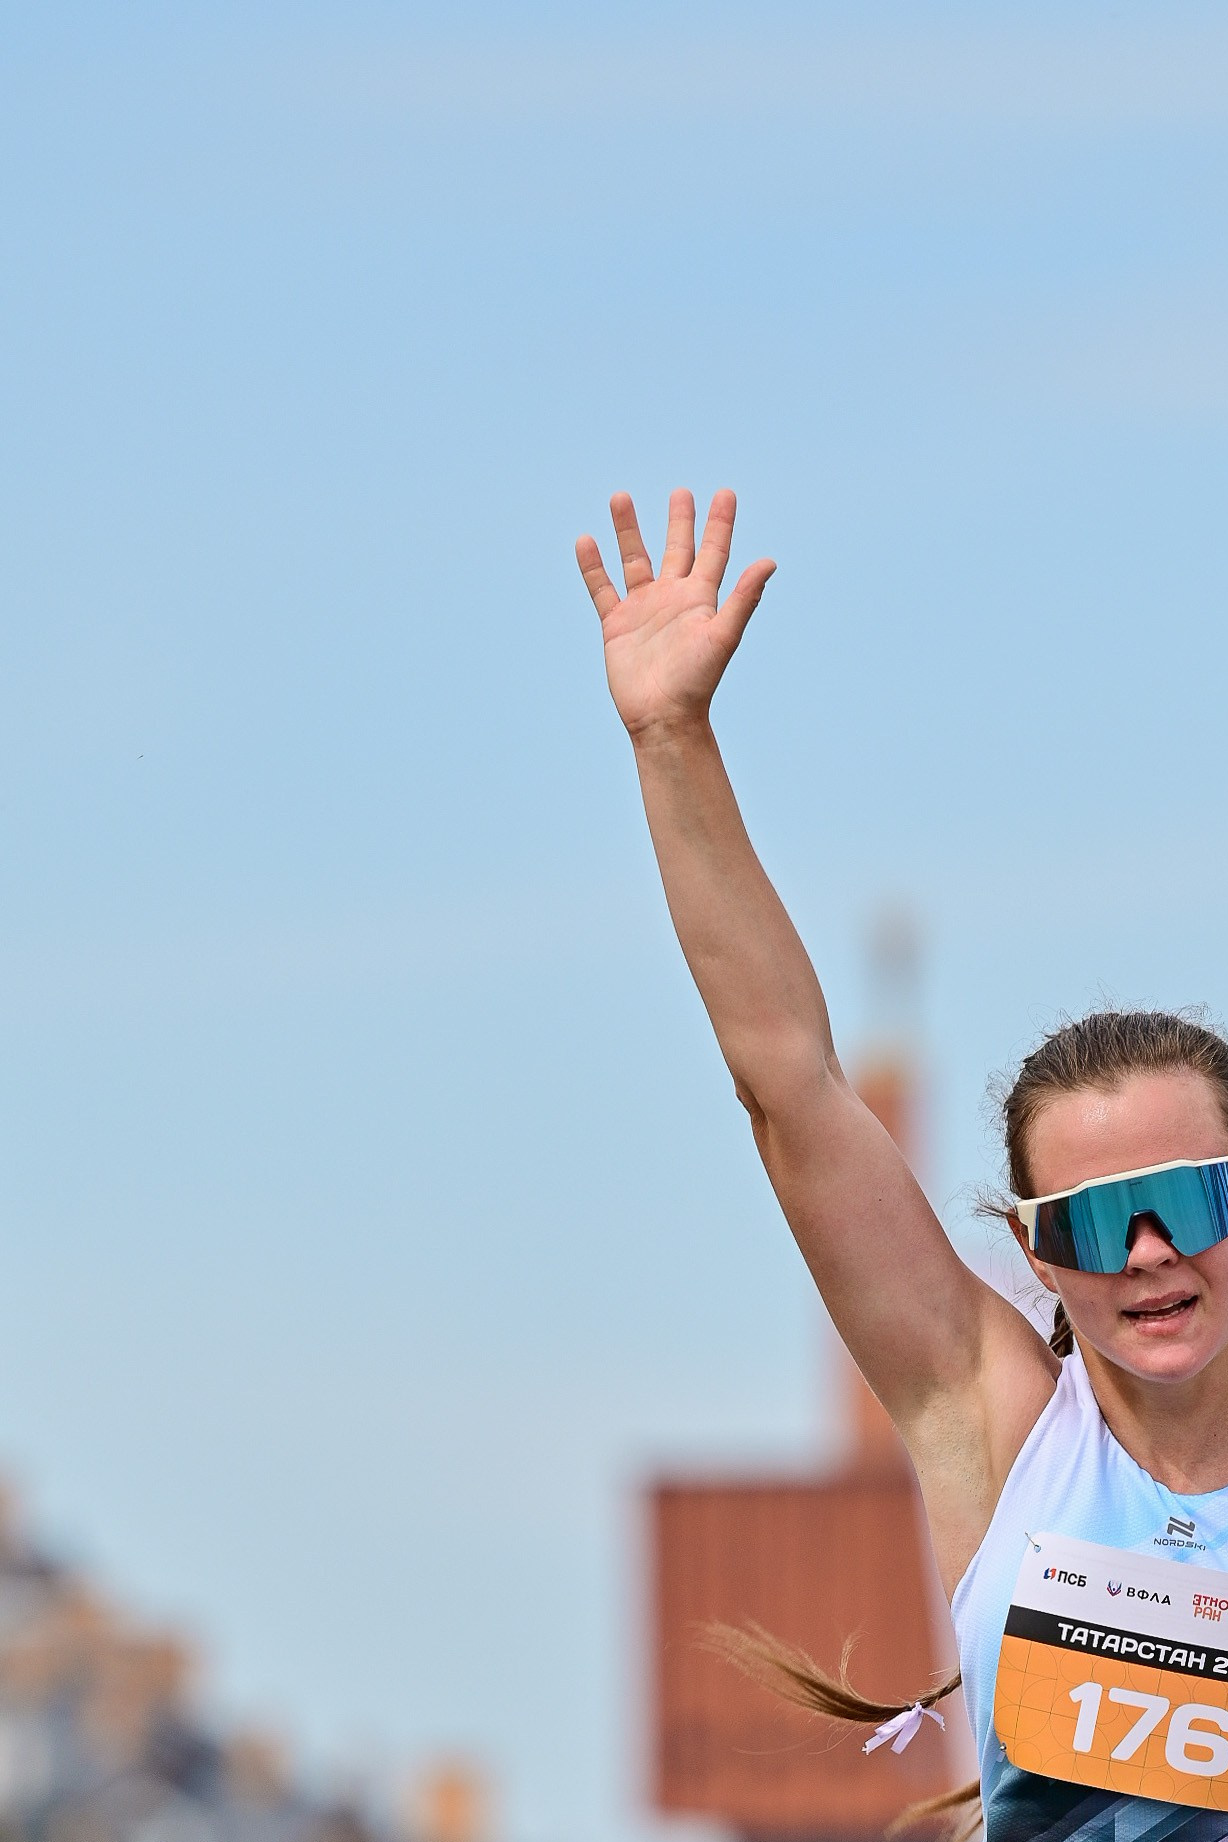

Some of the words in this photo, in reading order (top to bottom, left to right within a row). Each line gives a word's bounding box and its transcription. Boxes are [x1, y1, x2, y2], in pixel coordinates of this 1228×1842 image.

[1153, 1537, 1206, 1551] NORDSKI
[1057, 1570, 1087, 1588] ПСБ
[1126, 1586, 1172, 1606] ВФЛА
[1193, 1606, 1222, 1622] РАН
[1057, 1622, 1206, 1670] ТАТАРСТАН
